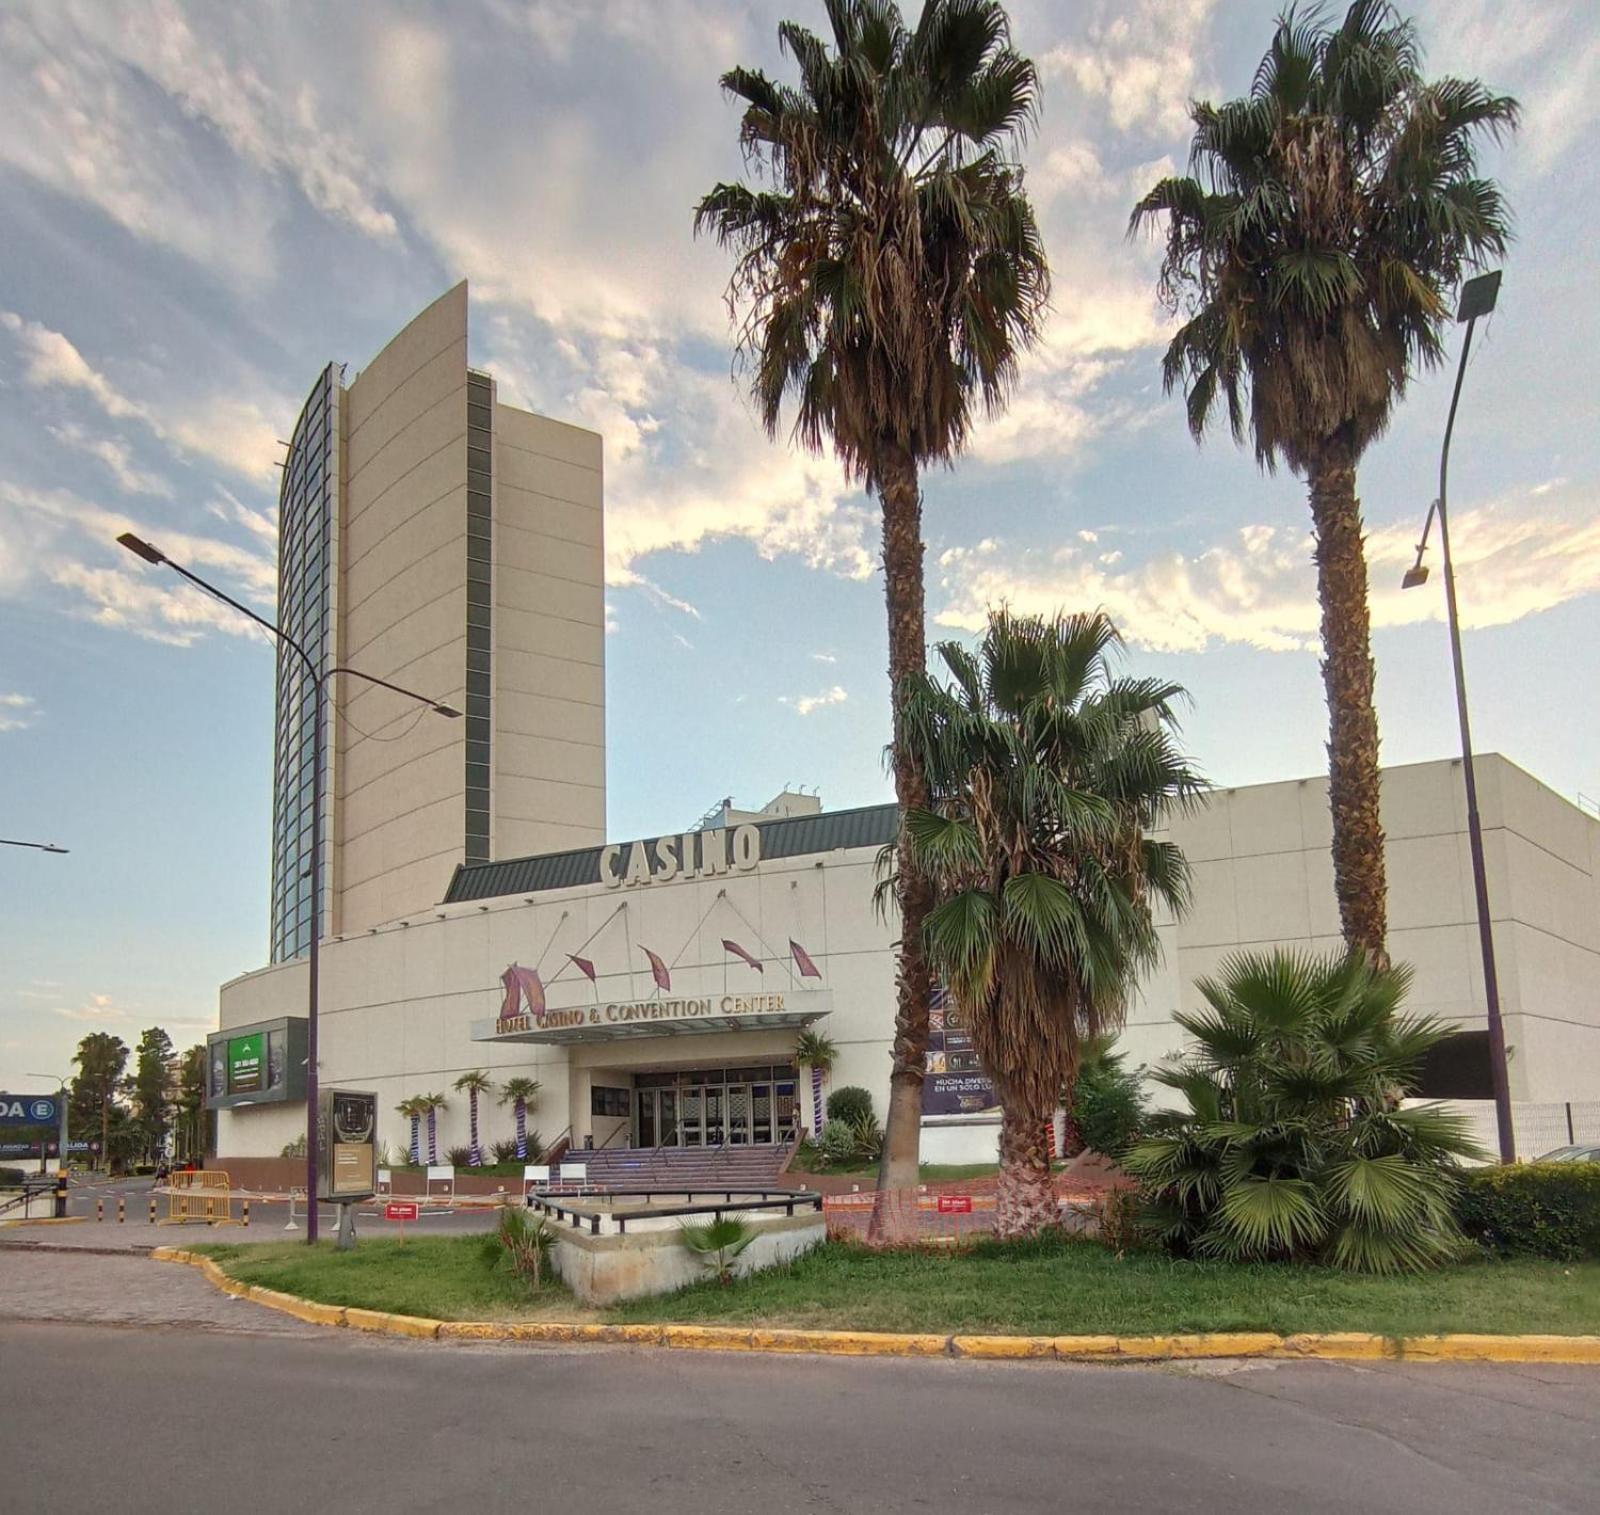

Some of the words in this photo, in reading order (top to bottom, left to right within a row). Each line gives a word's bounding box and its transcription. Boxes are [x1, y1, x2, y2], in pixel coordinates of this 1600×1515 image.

[600, 824, 761, 888] CASINO
[496, 1015, 530, 1034] HOTEL
[537, 1009, 584, 1029] CASINO
[589, 1008, 600, 1023] &
[606, 1001, 711, 1021] CONVENTION
[721, 993, 786, 1014] CENTER
